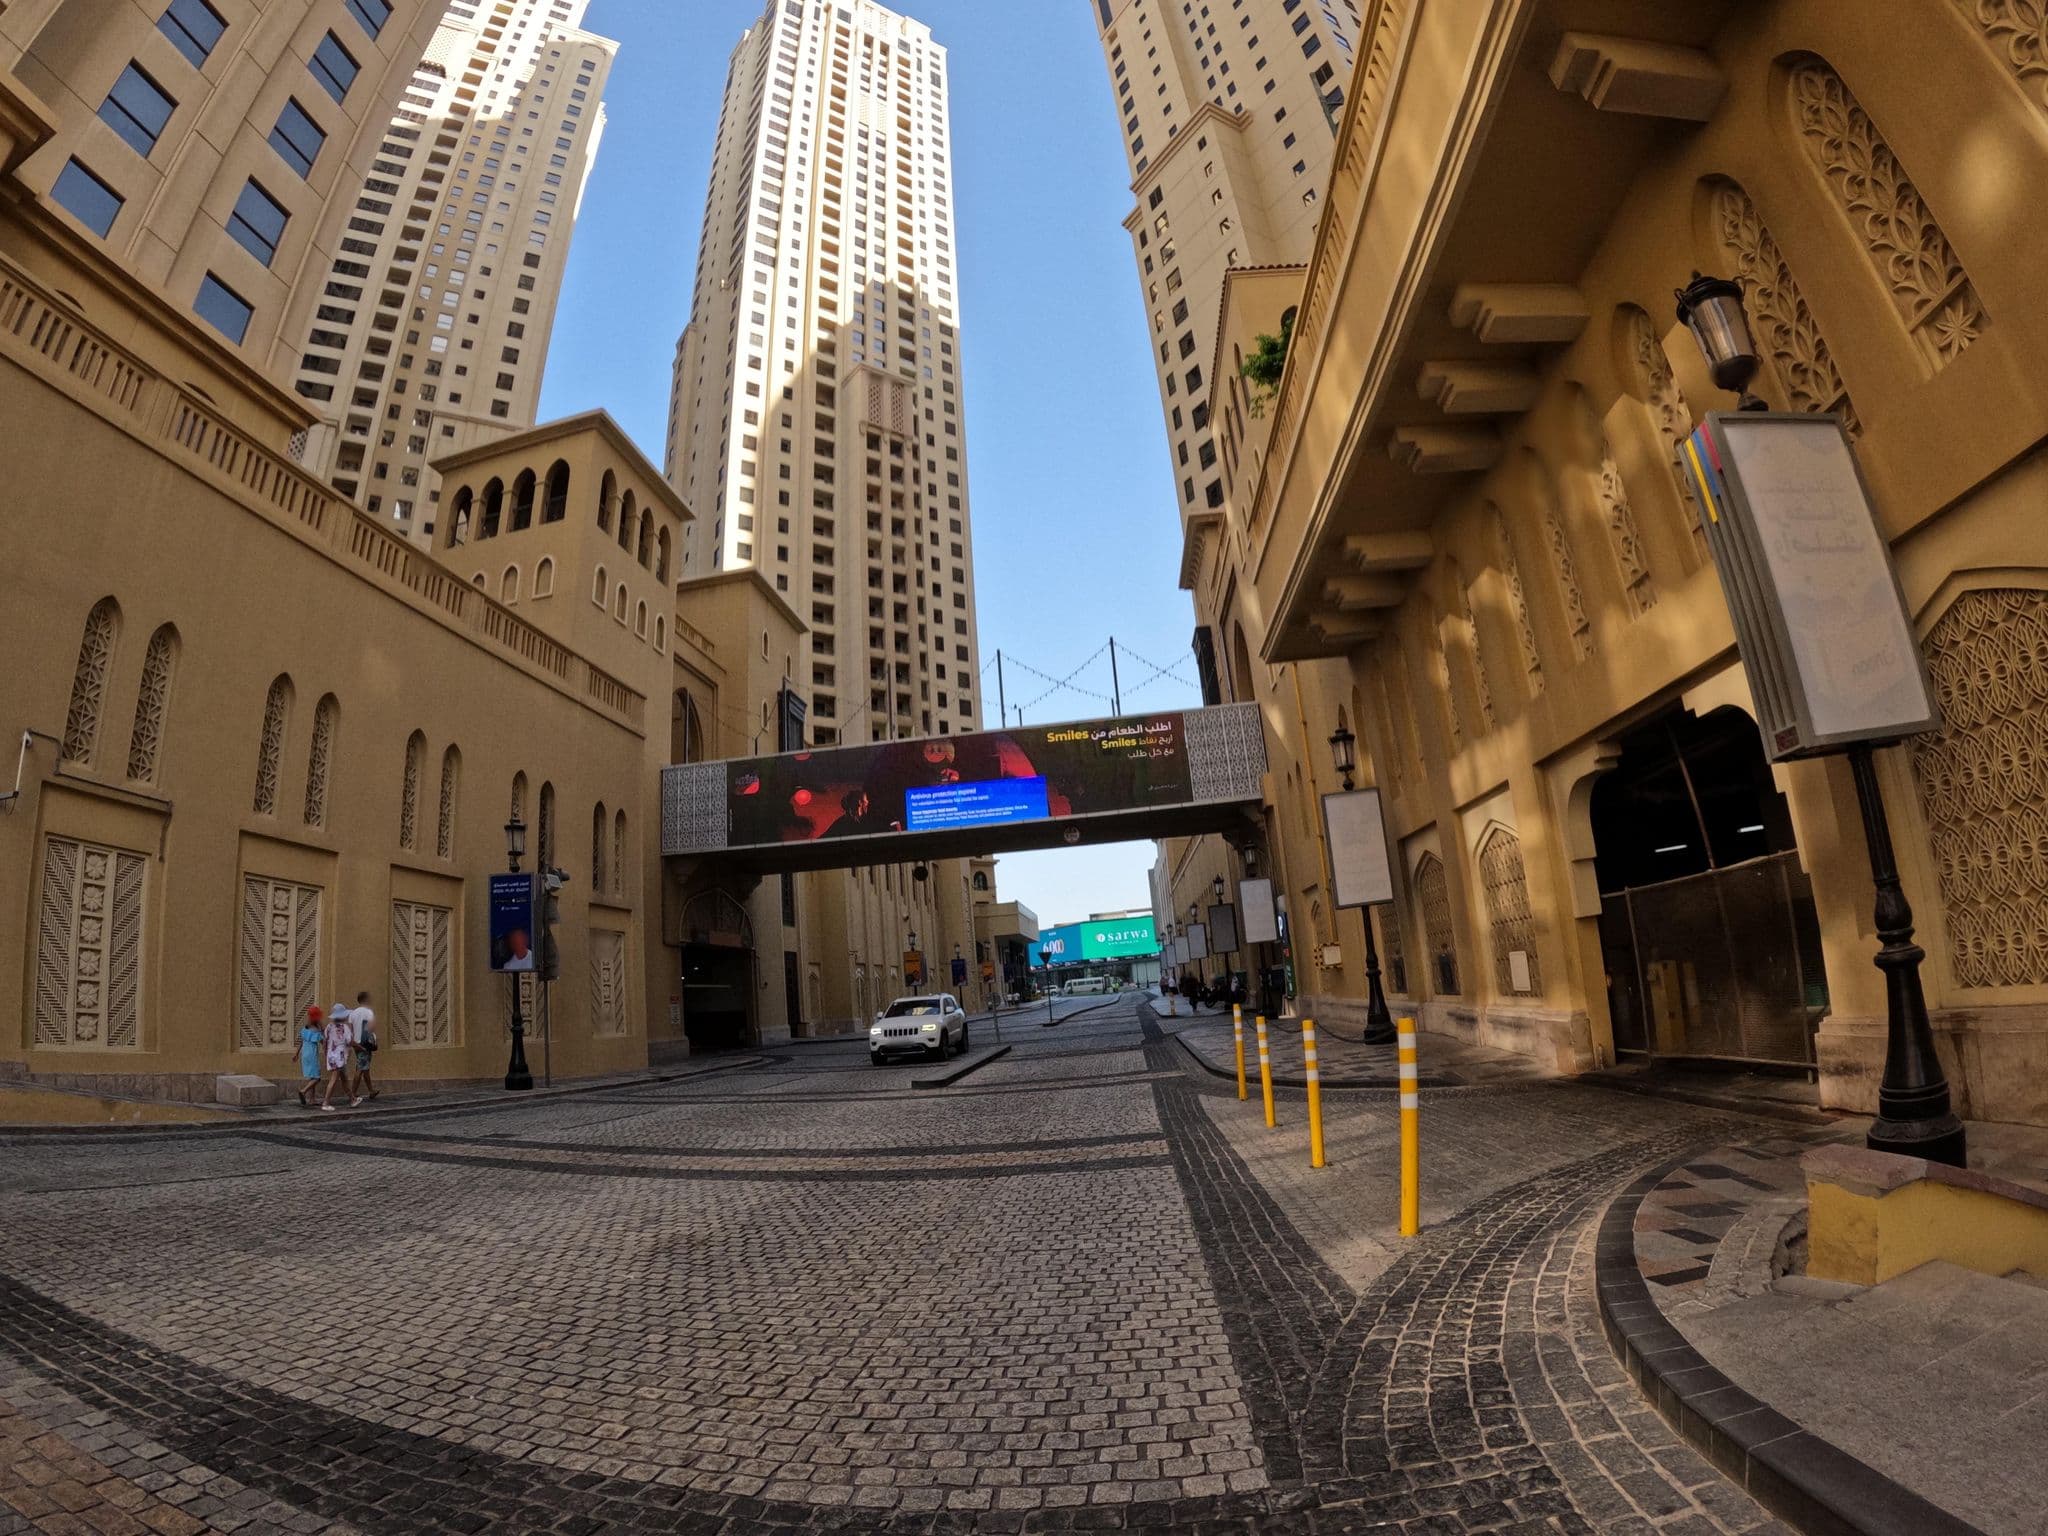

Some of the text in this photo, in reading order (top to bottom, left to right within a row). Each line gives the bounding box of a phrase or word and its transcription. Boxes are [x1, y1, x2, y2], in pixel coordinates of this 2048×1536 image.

[1047, 730, 1089, 742] Smiles
[1091, 731, 1106, 740] من
[1108, 724, 1143, 738] الطعام
[1101, 737, 1137, 749] Smiles
[1127, 747, 1175, 759] مع كل طلب
[1107, 929, 1148, 942] sarwa
